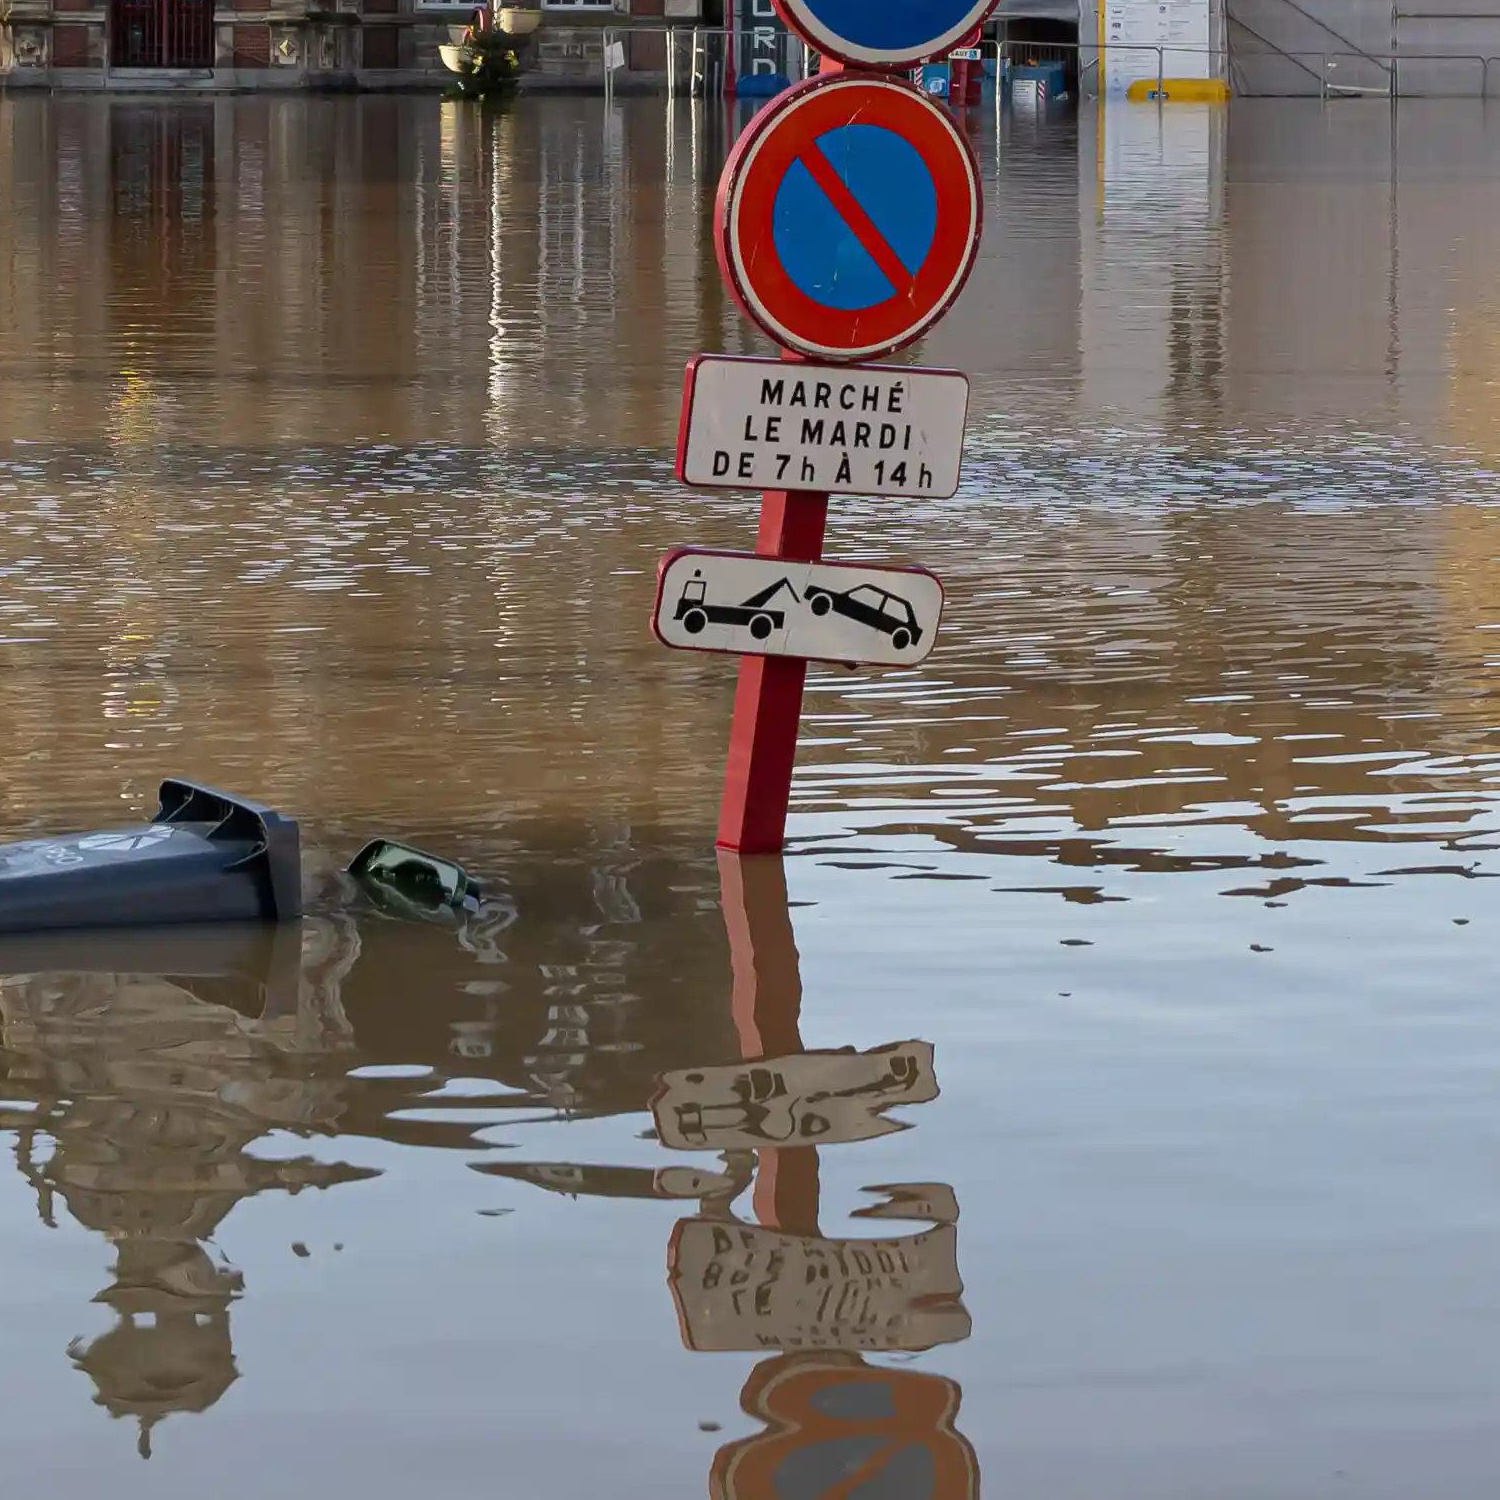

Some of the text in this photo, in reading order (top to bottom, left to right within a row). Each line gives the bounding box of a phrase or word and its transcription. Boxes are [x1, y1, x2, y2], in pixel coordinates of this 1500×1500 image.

[760, 378, 905, 414] MARCHÉ
[744, 415, 913, 451] LE MARDI
[712, 450, 756, 479] DE
[834, 451, 852, 485] À
